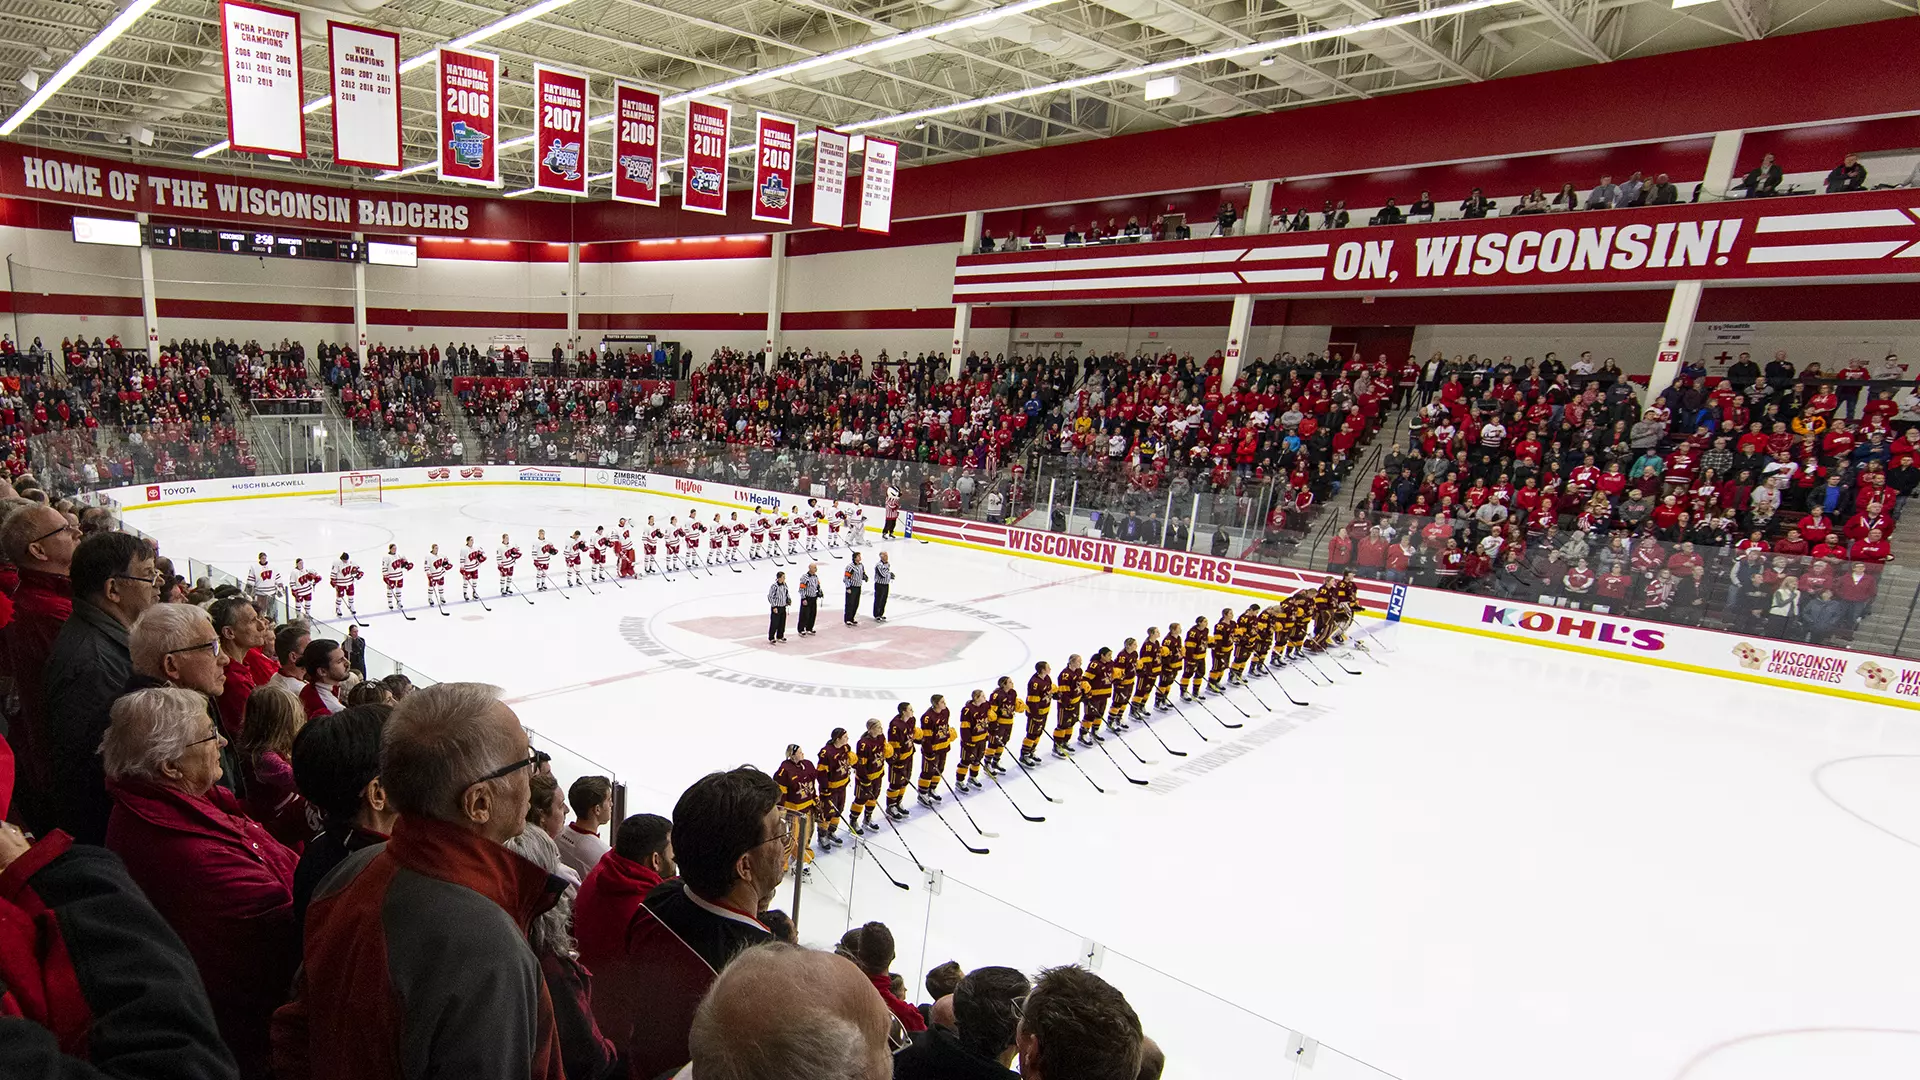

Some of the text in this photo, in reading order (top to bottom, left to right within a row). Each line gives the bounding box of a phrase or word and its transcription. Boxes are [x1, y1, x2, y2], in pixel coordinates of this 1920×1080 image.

[234, 22, 289, 40] WCHA PLAYOFF
[242, 33, 283, 48] CHAMPIONS
[355, 46, 374, 56] WCHA
[236, 61, 251, 70] 2011
[345, 54, 384, 67] CHAMPIONS
[446, 64, 488, 81] NATIONAL
[446, 76, 488, 92] CHAMPIONS
[544, 83, 581, 99] NATIONAL
[448, 88, 489, 118] 2006
[544, 94, 581, 108] CHAMPIONS
[622, 99, 654, 114] NATIONAL
[544, 106, 581, 132] 2007
[622, 109, 654, 122] CHAMPIONS
[694, 114, 724, 127] NATIONAL
[622, 120, 654, 146] 2009
[694, 123, 724, 136] CHAMPIONS
[764, 129, 791, 142] NATIONAL
[694, 134, 722, 158] 2011
[764, 138, 791, 150] CHAMPIONS
[762, 148, 790, 170] 2019
[23, 156, 468, 230] HOME OF THE WISCONSIN BADGERS
[1333, 218, 1743, 283] ON, WISCONSIN!
[614, 472, 646, 480] ZIMBRICK
[614, 479, 646, 488] EUROPEAN
[163, 487, 196, 496] TOYOTA
[1008, 530, 1231, 584] WISCONSIN BADGERS
[1390, 585, 1406, 616] CCM
[1482, 604, 1664, 650] KOHL'S
[1772, 649, 1848, 673] WISCONSIN
[1768, 662, 1842, 684] CRANBERRIES
[696, 668, 900, 700] UNIVERSITY
[892, 726, 897, 734] 5
[779, 768, 785, 776] 1
